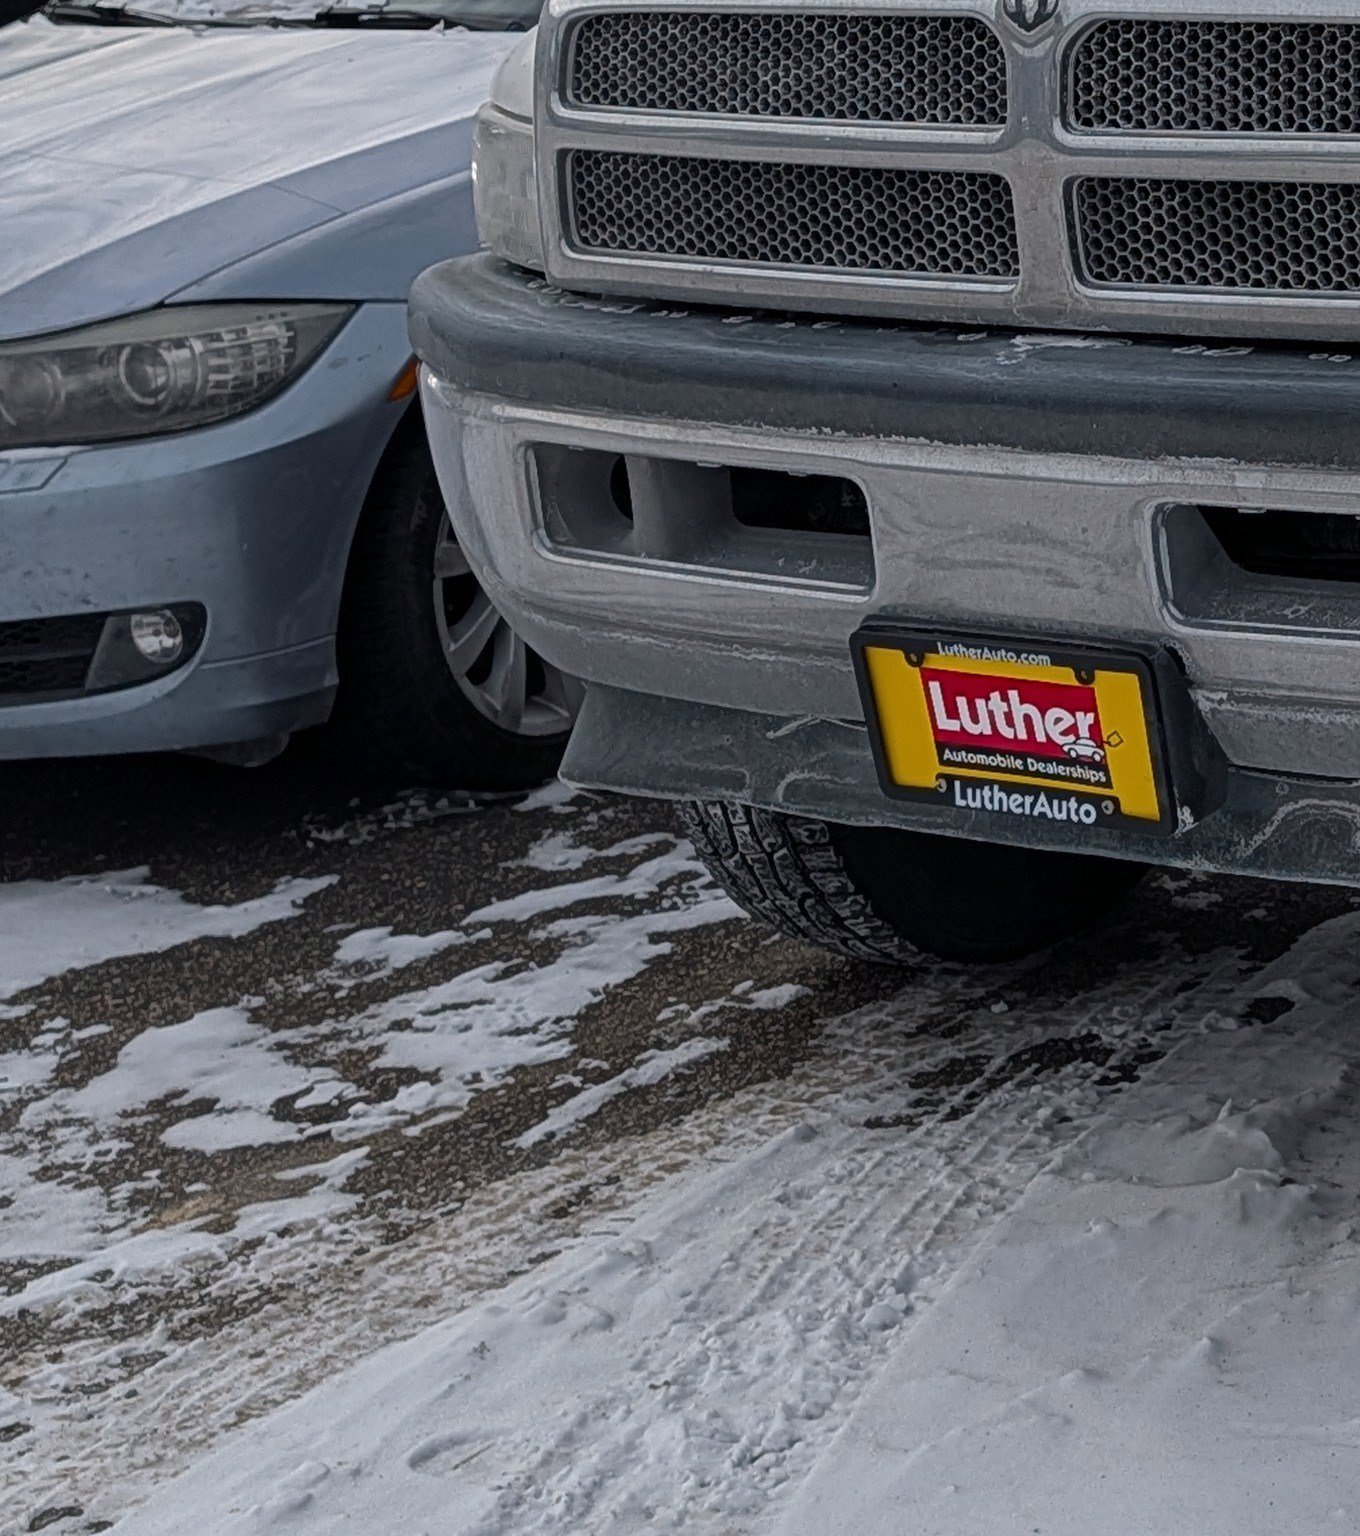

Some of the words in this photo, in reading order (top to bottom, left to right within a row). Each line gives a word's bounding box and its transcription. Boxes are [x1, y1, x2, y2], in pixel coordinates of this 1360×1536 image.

[936, 641, 1051, 667] LutherAuto.com
[928, 680, 1096, 744] Luther
[943, 748, 1024, 772] Automobile
[1027, 758, 1107, 784] Dealerships
[953, 780, 1098, 825] LutherAuto
